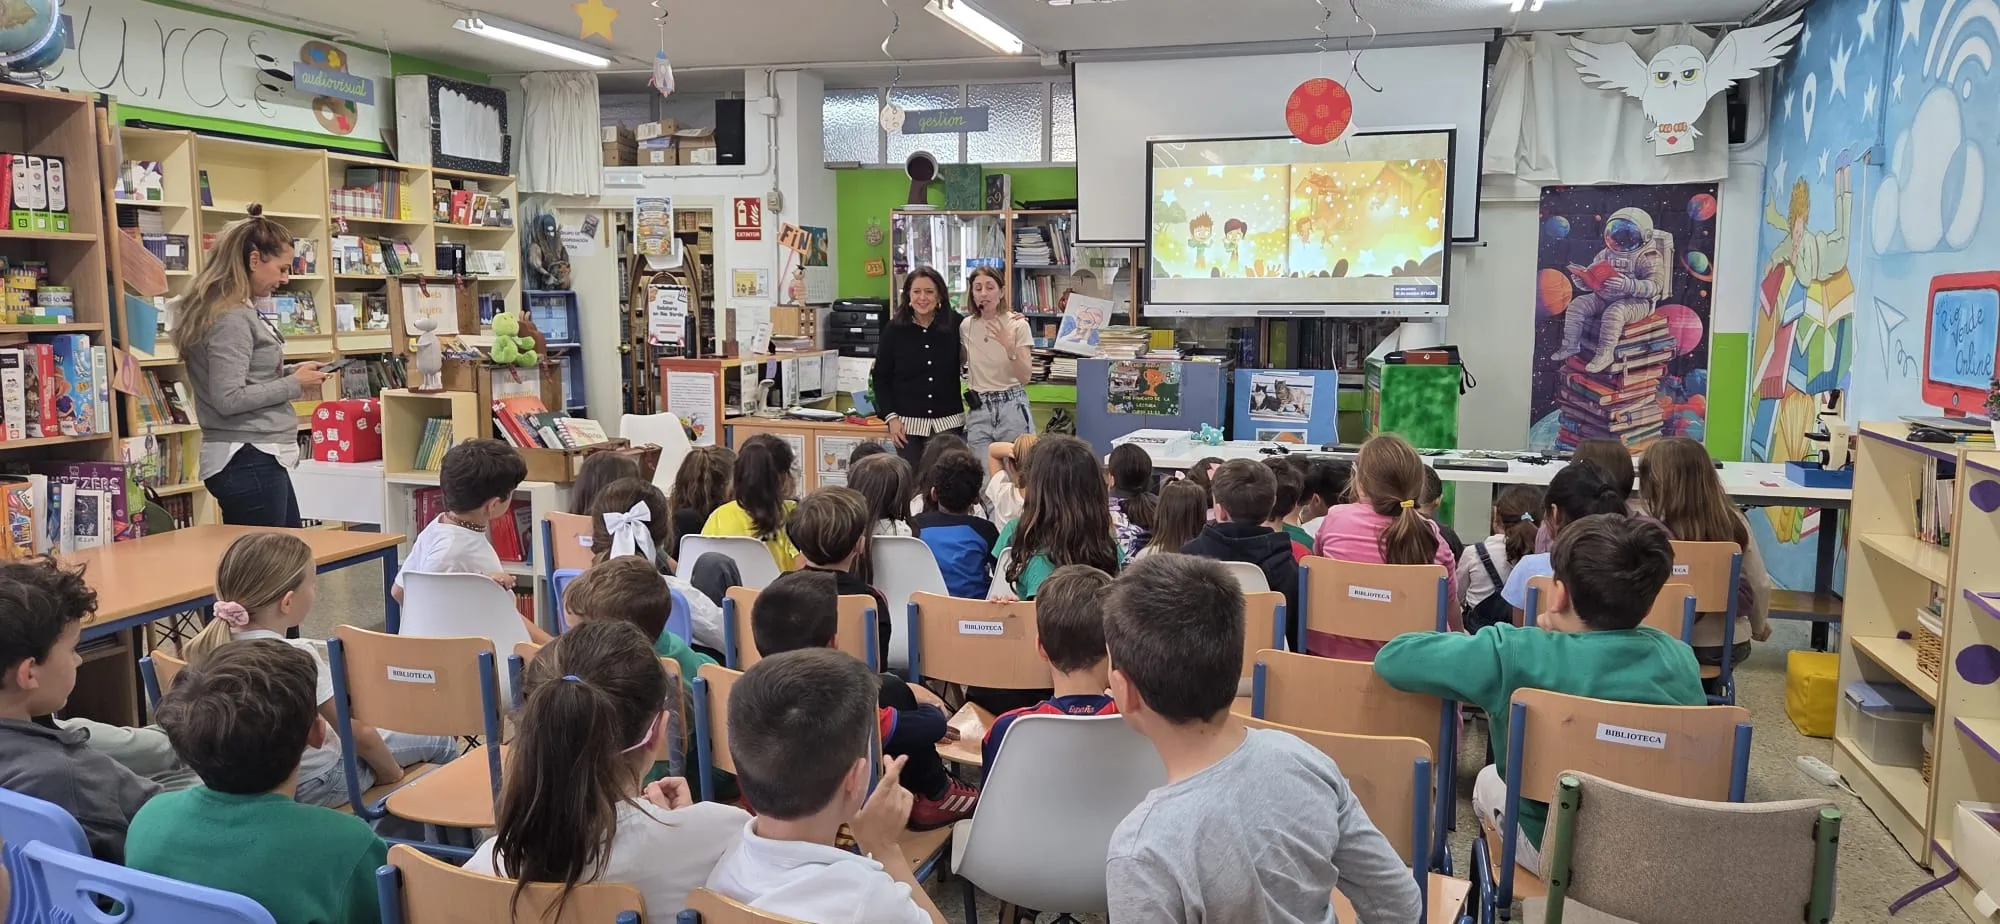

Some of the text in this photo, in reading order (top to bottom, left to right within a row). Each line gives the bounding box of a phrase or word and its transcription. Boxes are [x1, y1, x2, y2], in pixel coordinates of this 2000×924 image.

[301, 70, 367, 97] audiovisual
[1951, 303, 1985, 348] Verde
[1955, 340, 1992, 377] Online
[1354, 588, 1391, 600] BIBLIOTECA
[964, 623, 1002, 631] BIBLIOTECA
[392, 669, 433, 680] BIBLIOTECA
[1605, 728, 1662, 744] BIBLIOTECA
